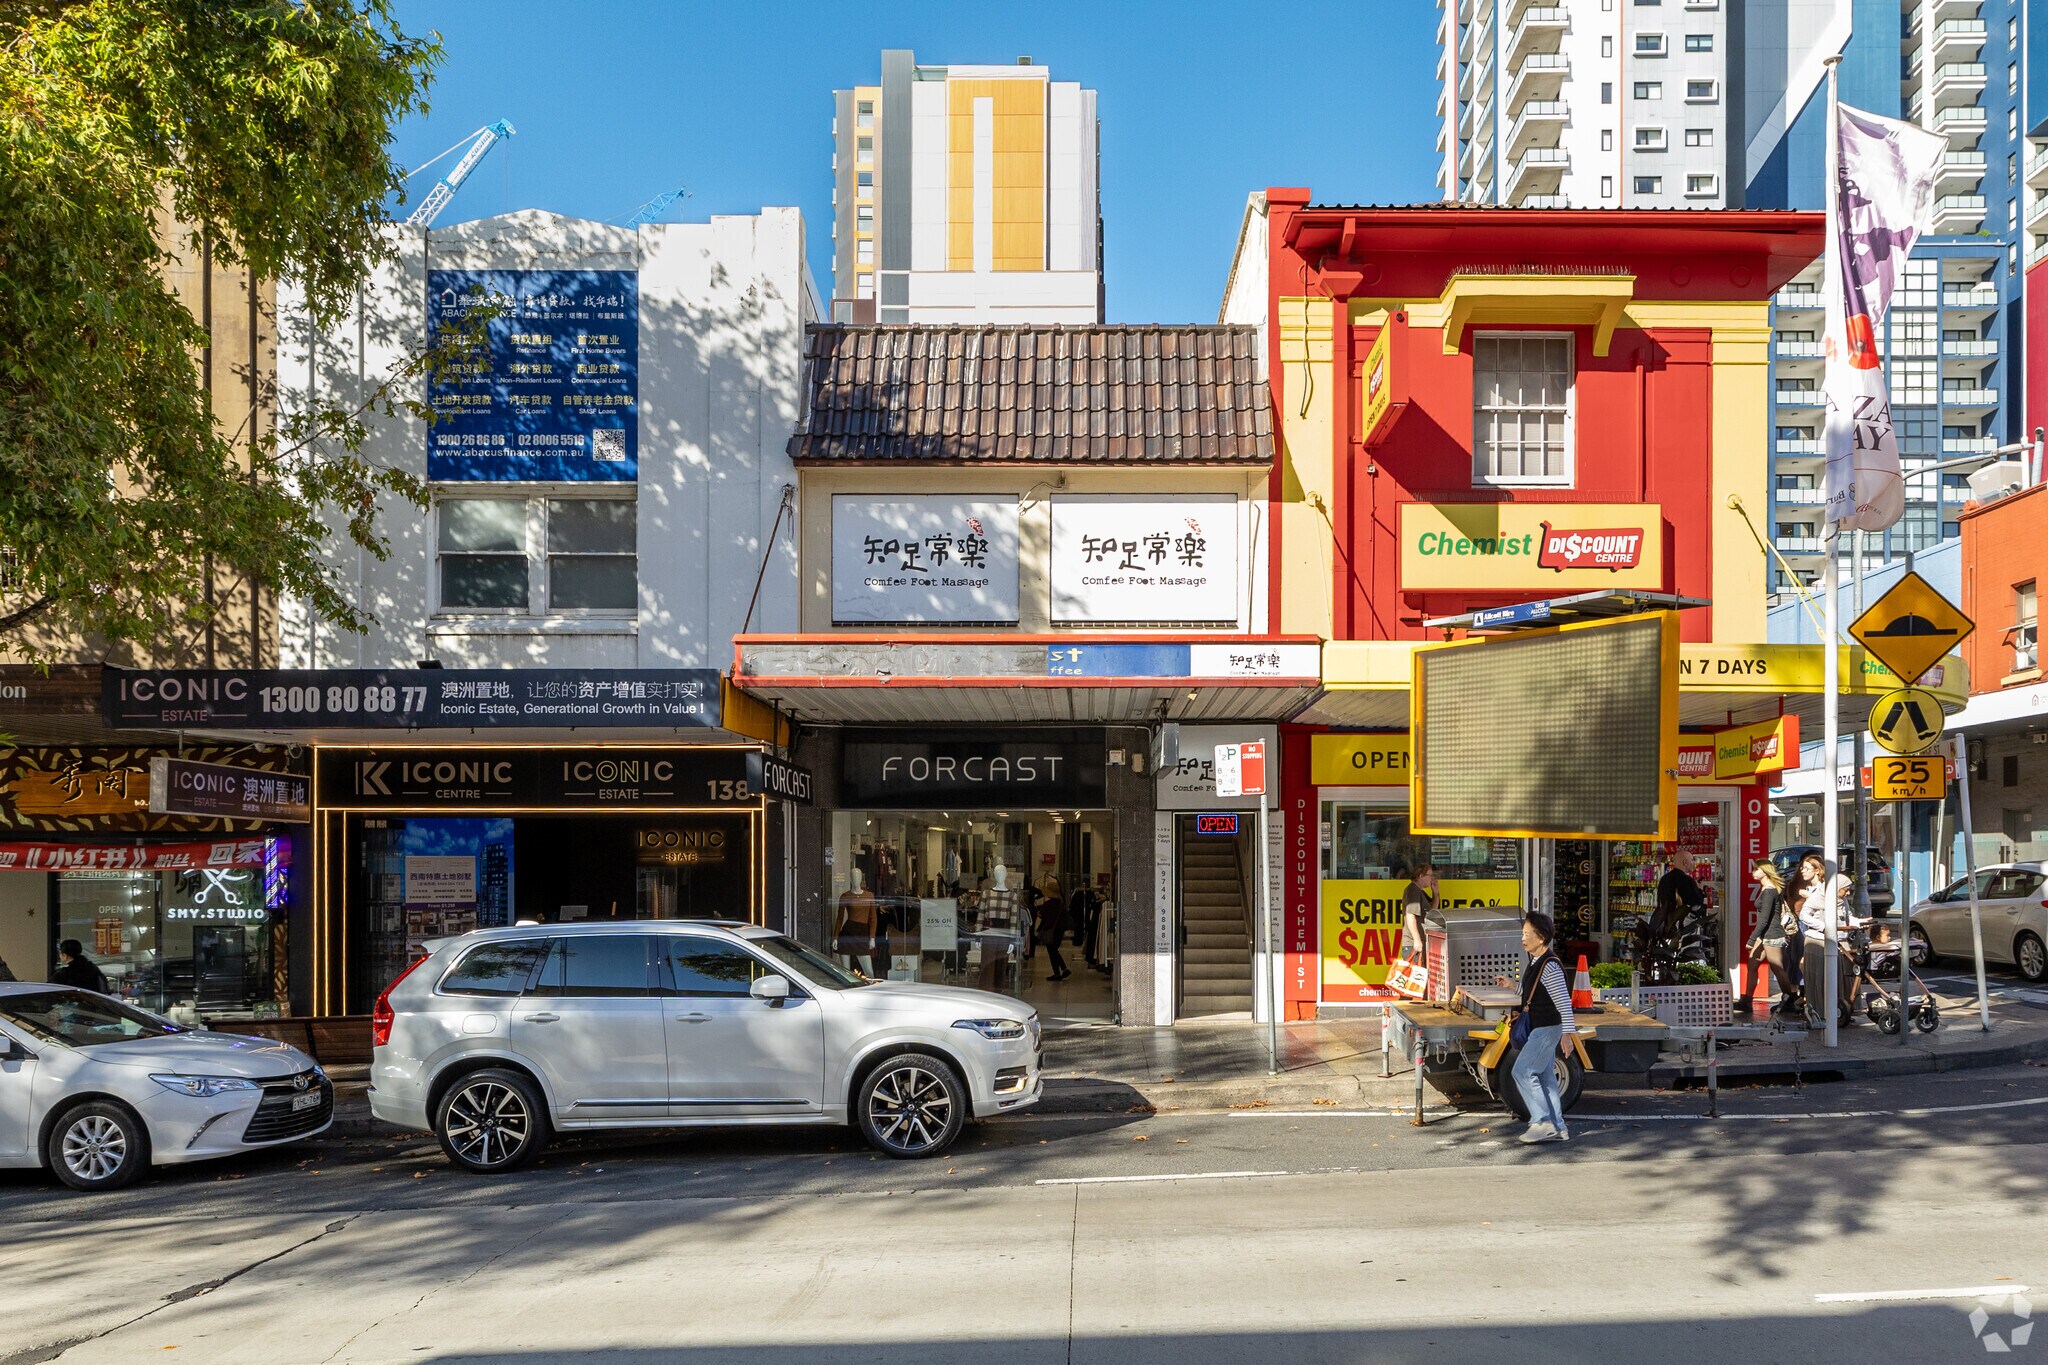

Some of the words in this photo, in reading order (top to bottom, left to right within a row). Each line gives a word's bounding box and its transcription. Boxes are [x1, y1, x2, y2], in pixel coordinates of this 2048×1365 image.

[510, 334, 552, 345] 贷款重组
[577, 334, 620, 345] 首次置业
[605, 347, 627, 355] Buyers
[510, 363, 552, 374] 海外贷款
[577, 363, 620, 374] 商业贷款
[432, 395, 492, 406] 土地开发贷款
[509, 395, 552, 406] 汽车贷款
[563, 395, 634, 406] 自管养老金贷款
[436, 434, 461, 446] 1300
[462, 434, 475, 446] 26
[476, 434, 490, 446] 86
[491, 434, 505, 446] 86
[518, 434, 532, 446] 02
[533, 434, 559, 446] 8006
[560, 434, 585, 446] 5516
[436, 448, 584, 457] www.abacusfinance.com.au
[1418, 531, 1532, 556] Chemist
[864, 532, 989, 572] 知足常樂
[1081, 532, 1206, 571] 知足常樂
[1595, 554, 1633, 563] CENTRE
[864, 576, 906, 587] Comfee
[911, 577, 937, 587] Foot
[942, 577, 989, 588] Massage
[1082, 575, 1124, 586] Comfee
[1129, 576, 1154, 586] Foot
[1159, 576, 1207, 587] Massage
[1699, 660, 1710, 674] 7
[1717, 660, 1767, 675] DAYS
[1860, 660, 1894, 676] Che
[121, 678, 248, 702] ICONIC
[259, 686, 320, 713] 1300
[326, 686, 359, 713] 80
[363, 686, 396, 713] 88
[402, 686, 428, 712] 77
[440, 703, 476, 714] Iconic
[479, 703, 520, 716] Estate,
[523, 703, 599, 714] Generational
[602, 703, 646, 714] Growth
[650, 703, 660, 714] in
[663, 703, 697, 714] Value
[162, 710, 208, 722] ESTATE
[1242, 752, 1263, 760] STOPPING
[1719, 743, 1748, 760] Chemist
[403, 761, 513, 783] ICONIC
[564, 761, 674, 783] ICONIC
[882, 757, 1063, 781] FORCAST
[1887, 762, 1930, 784] 25
[174, 770, 236, 794] ICONIC
[764, 761, 812, 800] FORCAST
[243, 776, 305, 807] 澳洲置地
[435, 789, 481, 799] CENTRE
[599, 788, 639, 799] ESTATE
[707, 780, 749, 800] 138
[1892, 786, 1927, 797] km/h
[193, 797, 217, 808] ESTATE
[1200, 817, 1235, 832] OPEN
[637, 831, 725, 847] ICONIC
[1297, 799, 1306, 897] DISCOUNT
[664, 852, 698, 862] ESTATE
[99, 905, 123, 914] OPEN
[167, 908, 265, 919] SMY.STUDIO
[1296, 904, 1306, 989] CHEMIST
